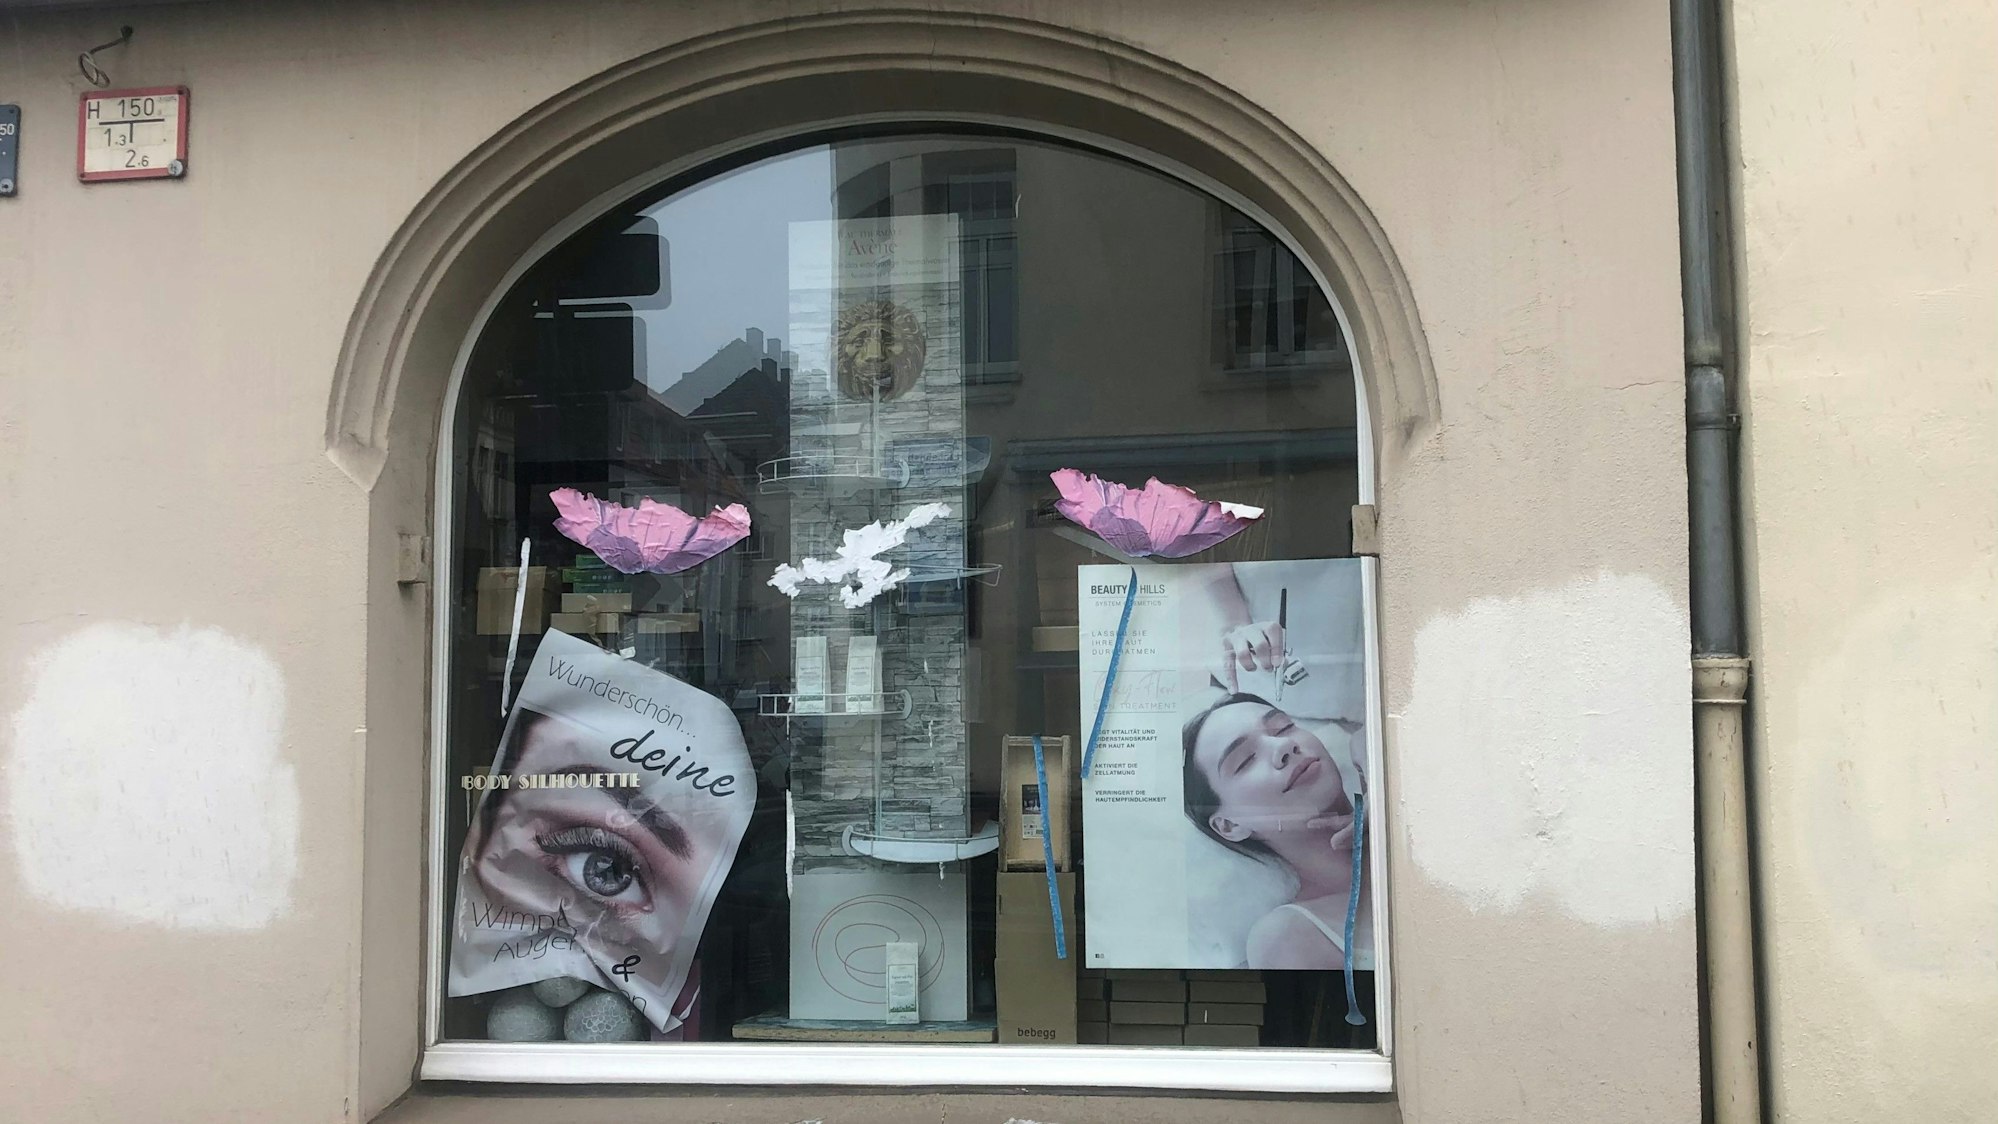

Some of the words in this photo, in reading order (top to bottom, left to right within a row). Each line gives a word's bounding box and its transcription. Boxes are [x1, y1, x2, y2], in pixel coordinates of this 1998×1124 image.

[87, 101, 100, 119] H
[118, 98, 154, 118] 150
[104, 128, 126, 147] 1.3
[125, 150, 149, 168] 2.6
[1091, 585, 1127, 594] BEAUTY
[1140, 584, 1165, 594] HILLS
[548, 655, 696, 738] Wunderschön...
[1120, 702, 1177, 710] TREATMENT
[610, 729, 735, 797] deine
[461, 774, 513, 791] BODY
[518, 772, 641, 790] SILHOUETTE
[611, 955, 641, 982] &
[1017, 1027, 1056, 1040] bebegg
